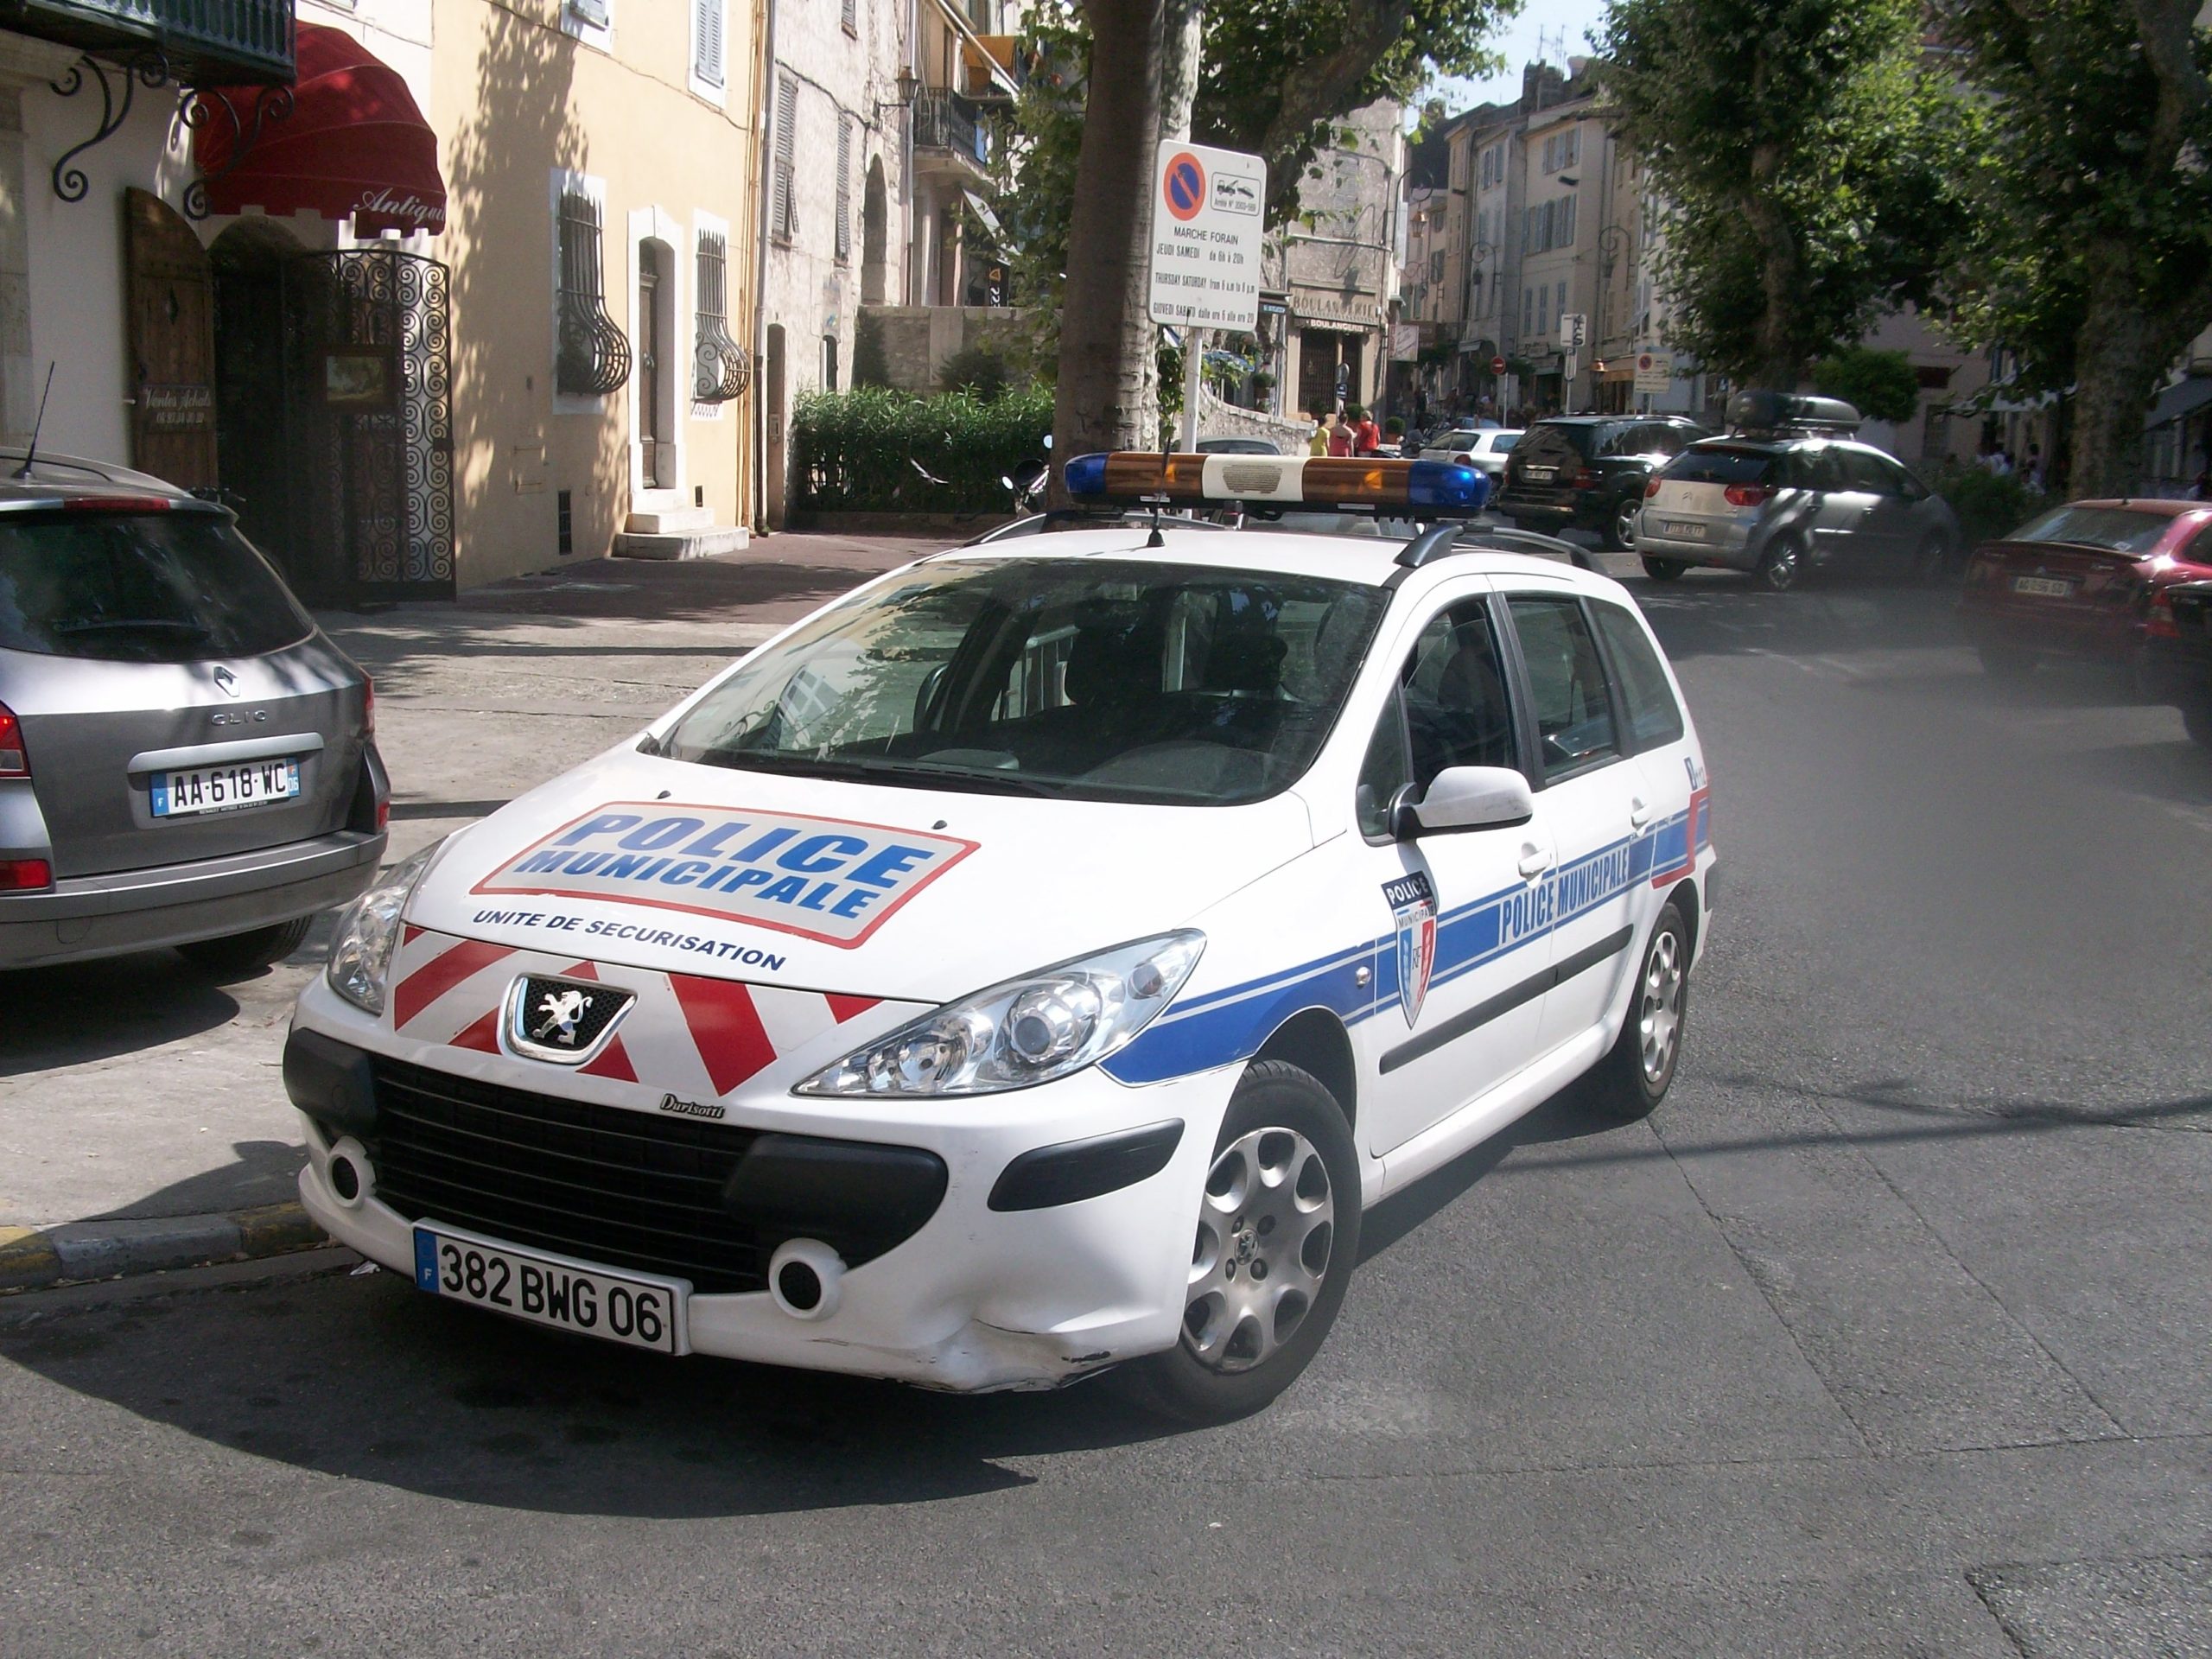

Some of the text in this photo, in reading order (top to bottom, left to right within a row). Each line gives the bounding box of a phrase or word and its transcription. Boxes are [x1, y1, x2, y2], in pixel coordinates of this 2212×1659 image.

[1174, 226, 1238, 245] MARCHE FORAIN
[1156, 243, 1174, 256] JEUDI
[1176, 245, 1200, 258] SAMEDI
[1210, 250, 1216, 261] de
[1233, 252, 1243, 264] 20h
[1155, 272, 1181, 286] THURSDAY
[1182, 275, 1207, 289] SATURDAY
[1210, 279, 1220, 290] from
[1153, 302, 1174, 315] GIOVEDI
[1198, 307, 1211, 319] dalle
[1227, 310, 1236, 321] alle
[1247, 313, 1255, 323] 20
[1311, 320, 1363, 332] BOULANGERIE
[211, 709, 267, 726] CLIO
[157, 798, 163, 807] F
[289, 777, 298, 791] 06
[552, 813, 935, 889] POLICE
[515, 849, 880, 920] MUNICIPALE
[1386, 877, 1428, 905] POLICE
[1502, 848, 1629, 944] POLICE MUNICIPALE
[473, 910, 787, 972] UNITE DE SECURISATION
[660, 1093, 726, 1118] Durisotti
[424, 1243, 662, 1342] F 382 BWG 06
